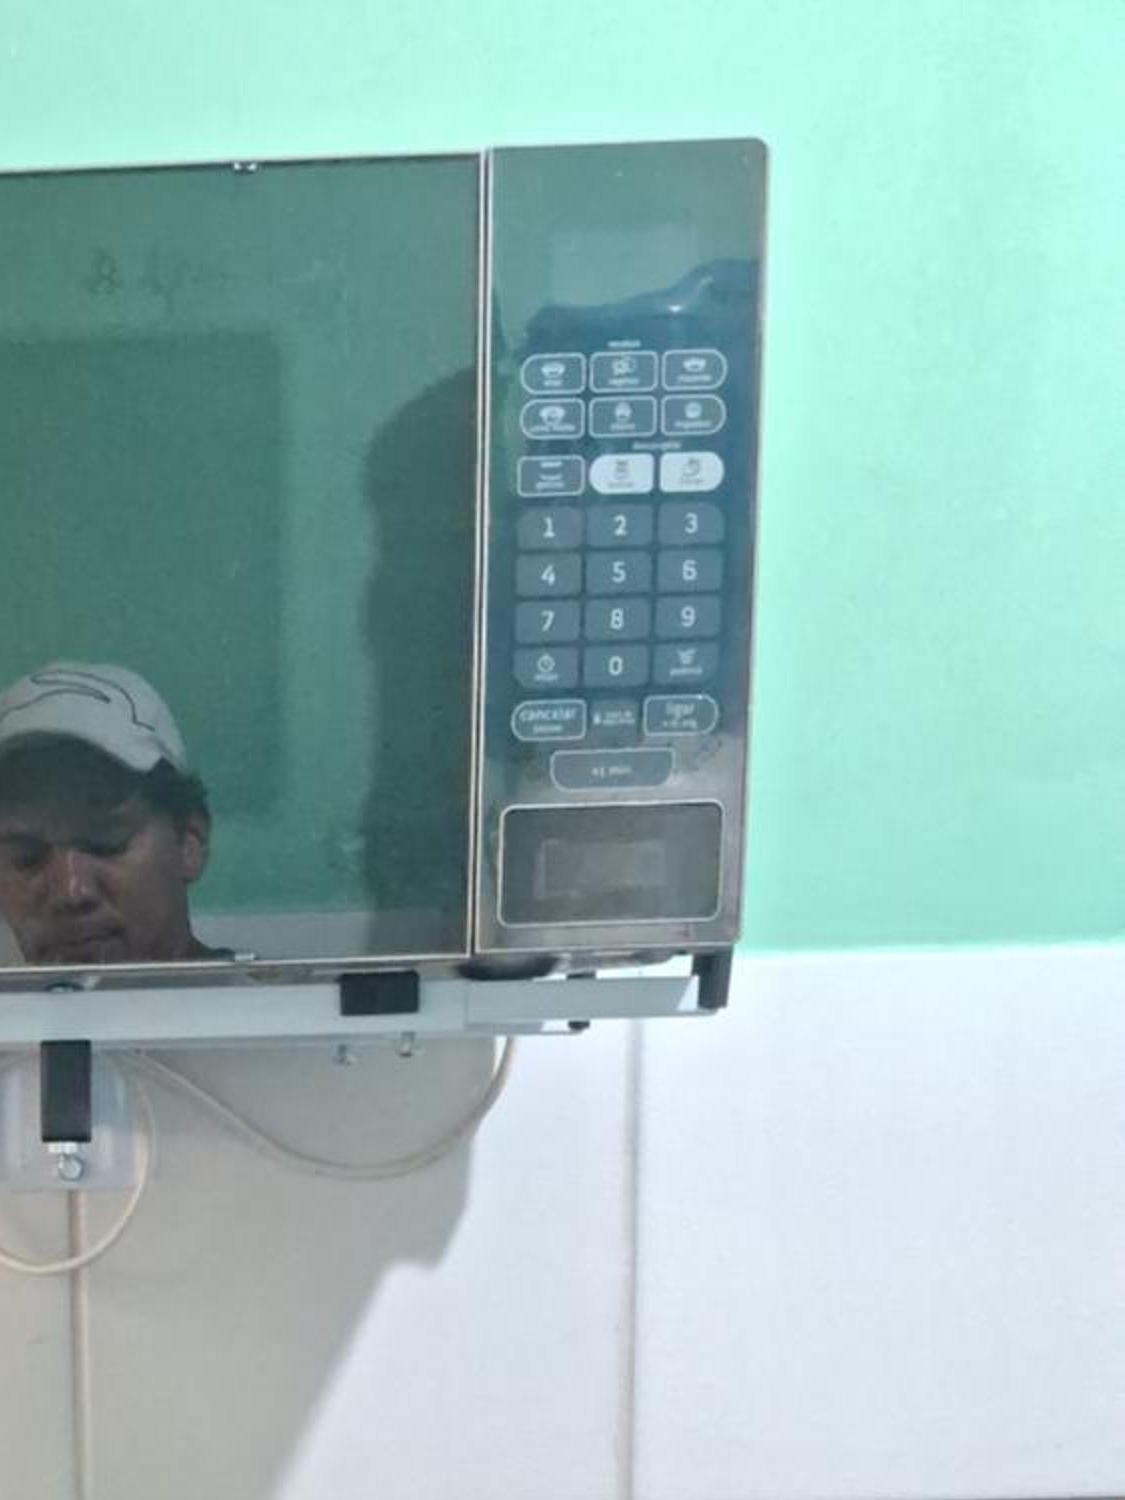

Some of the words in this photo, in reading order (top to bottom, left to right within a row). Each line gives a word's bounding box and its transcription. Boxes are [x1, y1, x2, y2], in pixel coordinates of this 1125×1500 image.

[543, 516, 555, 538] 1
[613, 514, 627, 536] 2
[684, 512, 698, 534] 3
[540, 564, 556, 585] 4
[612, 561, 626, 583] 5
[682, 559, 697, 581] 6
[541, 610, 555, 631] 7
[610, 608, 624, 630] 8
[680, 605, 696, 628] 9
[608, 655, 623, 676] 0
